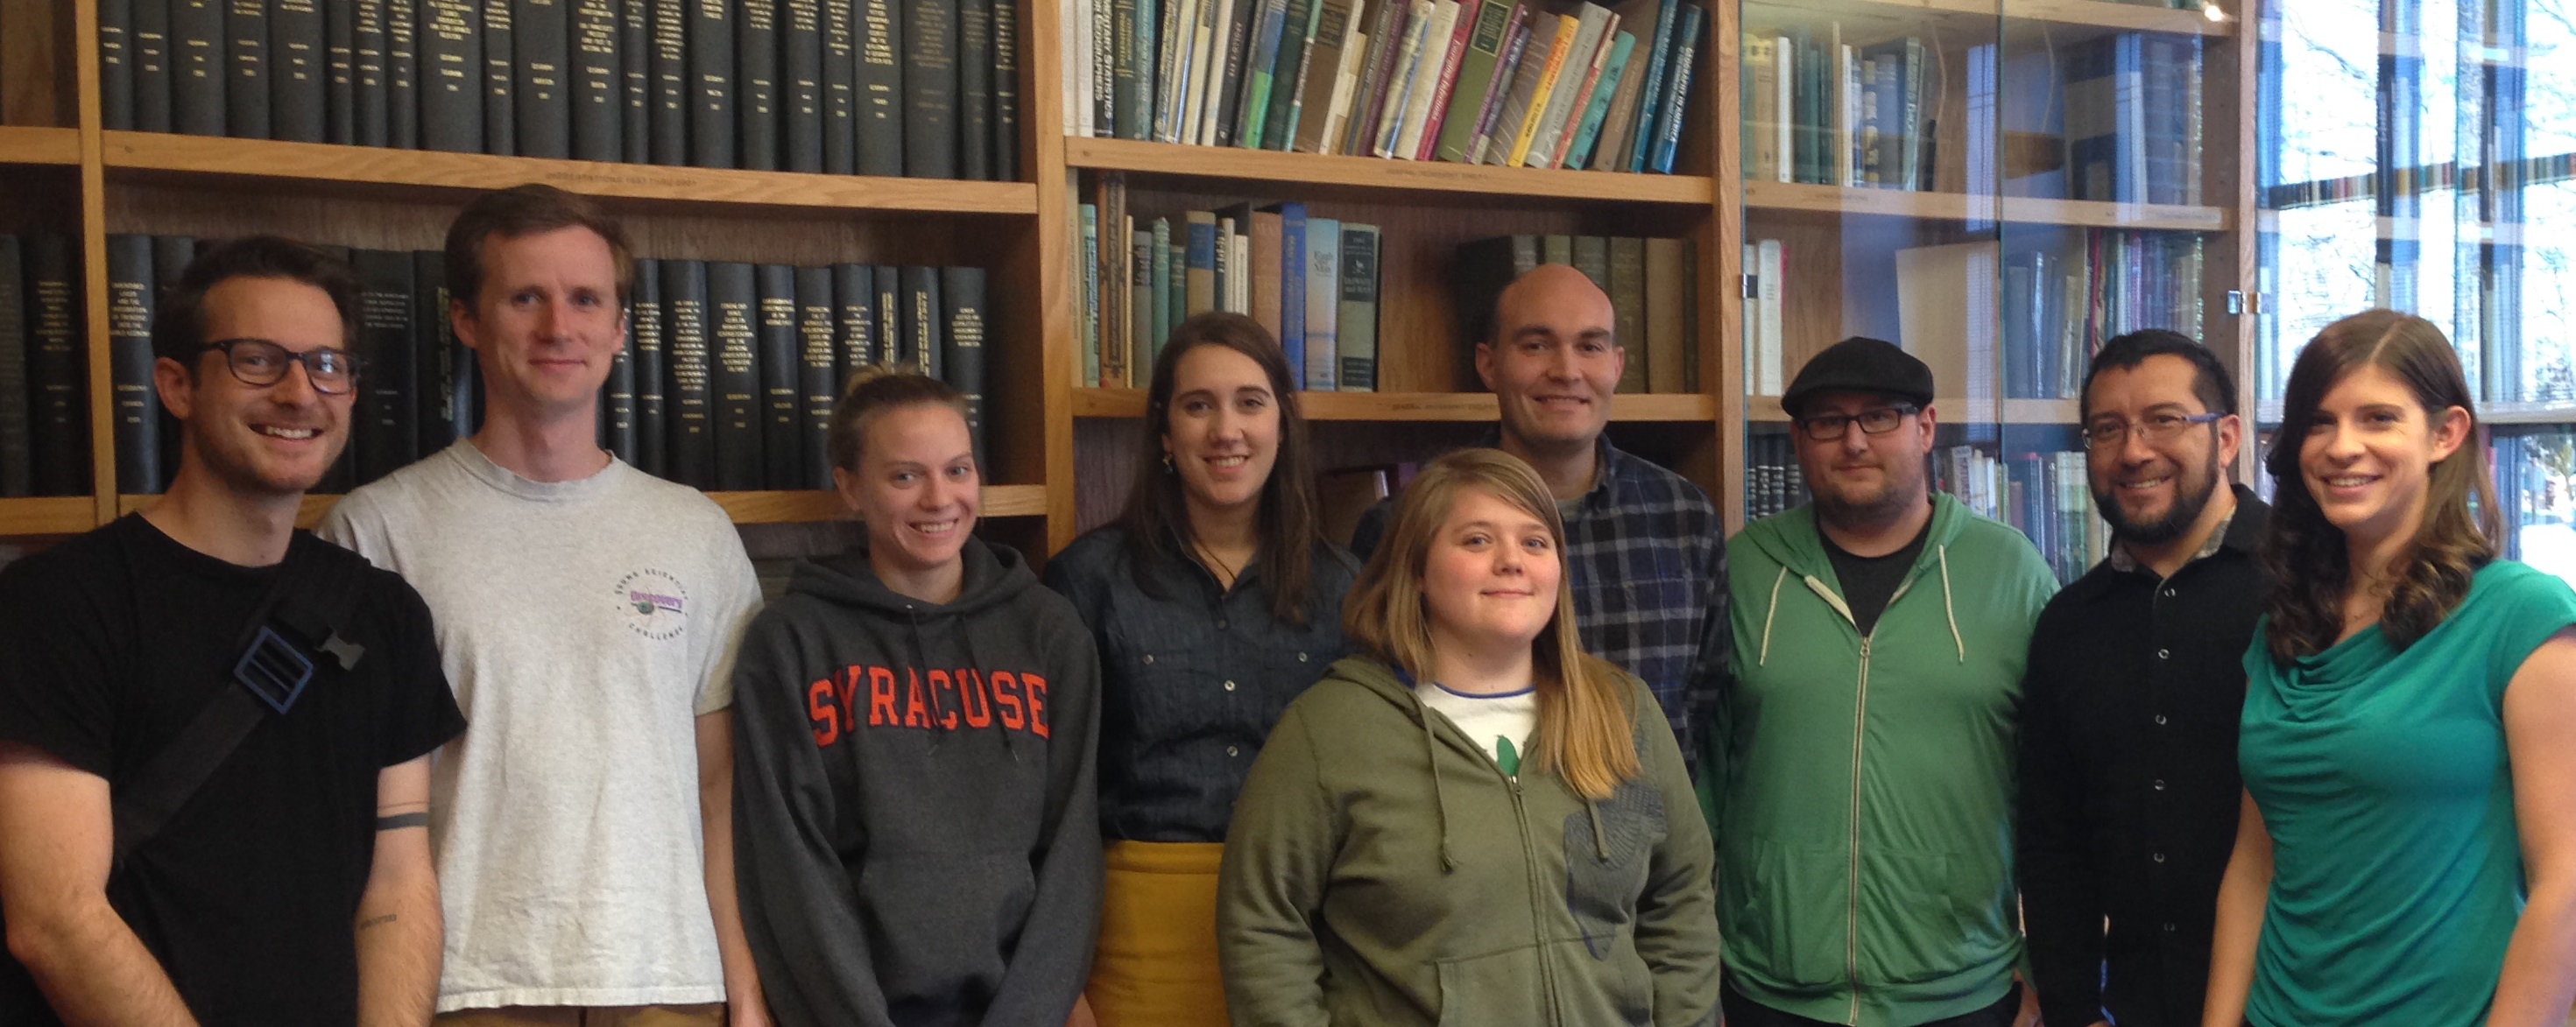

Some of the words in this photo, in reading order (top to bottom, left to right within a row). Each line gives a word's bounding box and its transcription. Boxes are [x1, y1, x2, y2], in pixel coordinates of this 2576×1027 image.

[1094, 13, 1104, 102] GEOGRAPHERS
[1679, 46, 1694, 95] GEOGRAPHY
[1104, 54, 1114, 119] STATISTICS
[1676, 95, 1686, 107] IN
[1670, 105, 1684, 143] AMERICA
[808, 664, 1050, 748] SYRACUSE
